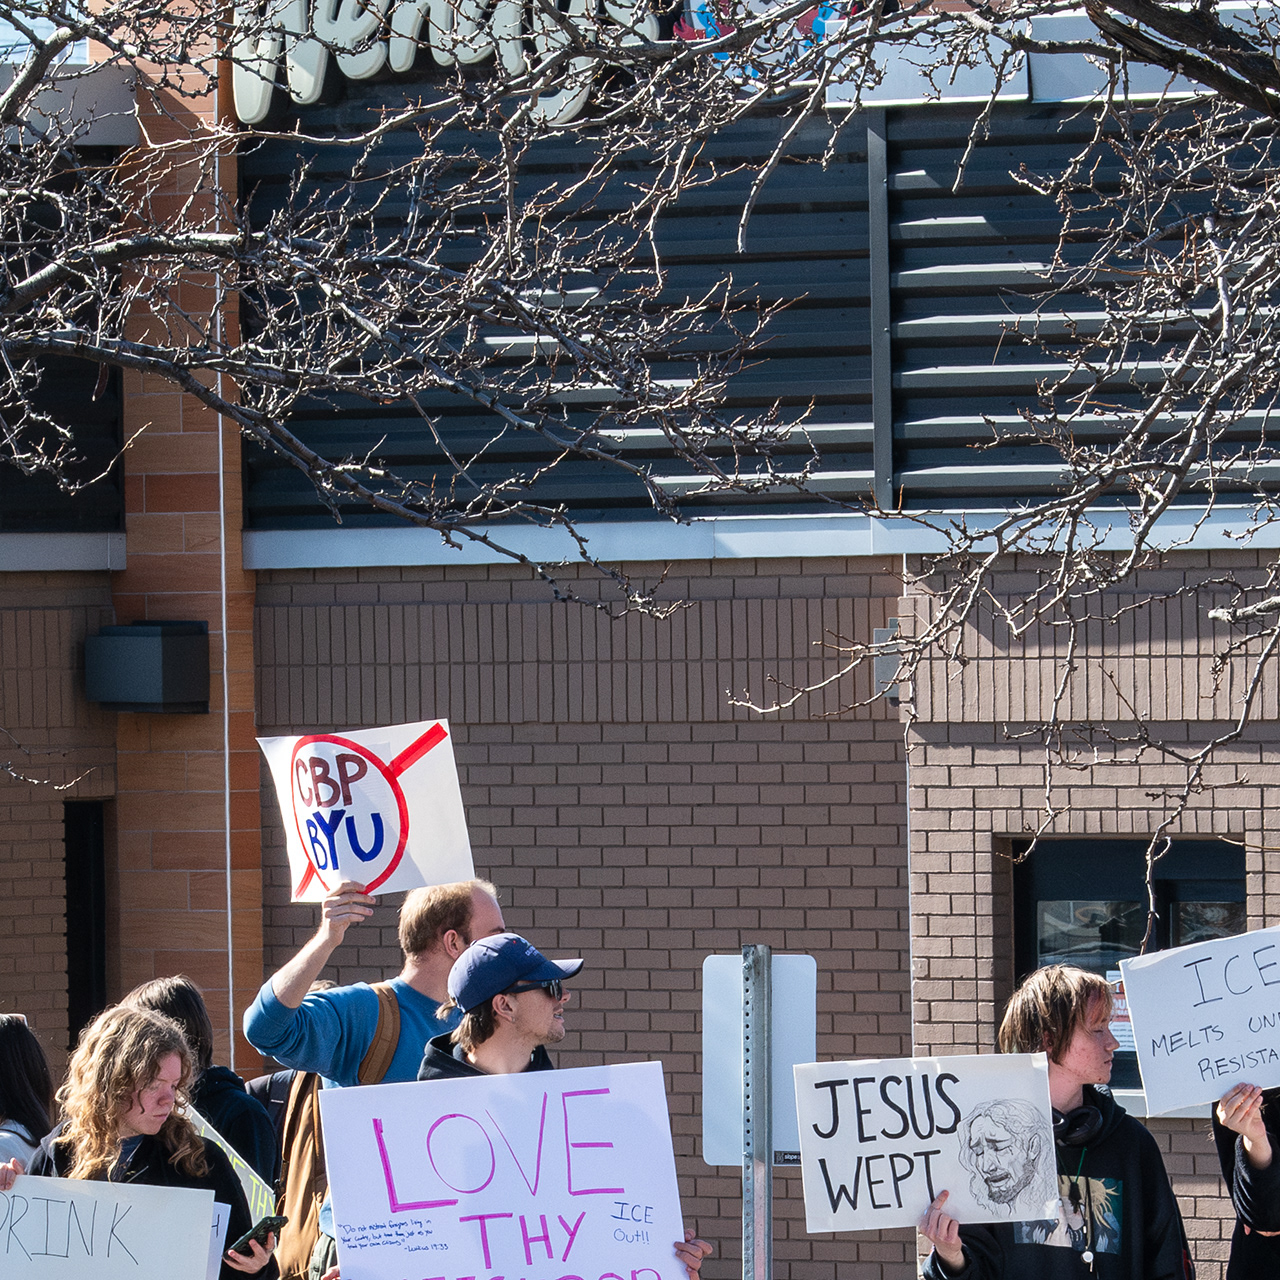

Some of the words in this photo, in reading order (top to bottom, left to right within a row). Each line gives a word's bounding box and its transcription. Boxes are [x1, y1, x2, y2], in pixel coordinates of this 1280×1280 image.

[295, 753, 368, 808] CBP
[306, 808, 384, 871] BYU
[1151, 1025, 1225, 1057] MELTS
[812, 1072, 961, 1144] JESUS
[372, 1087, 625, 1213] LOVE
[610, 1201, 654, 1224] ICE
[817, 1150, 942, 1214] WEPT
[459, 1211, 586, 1270] THY
